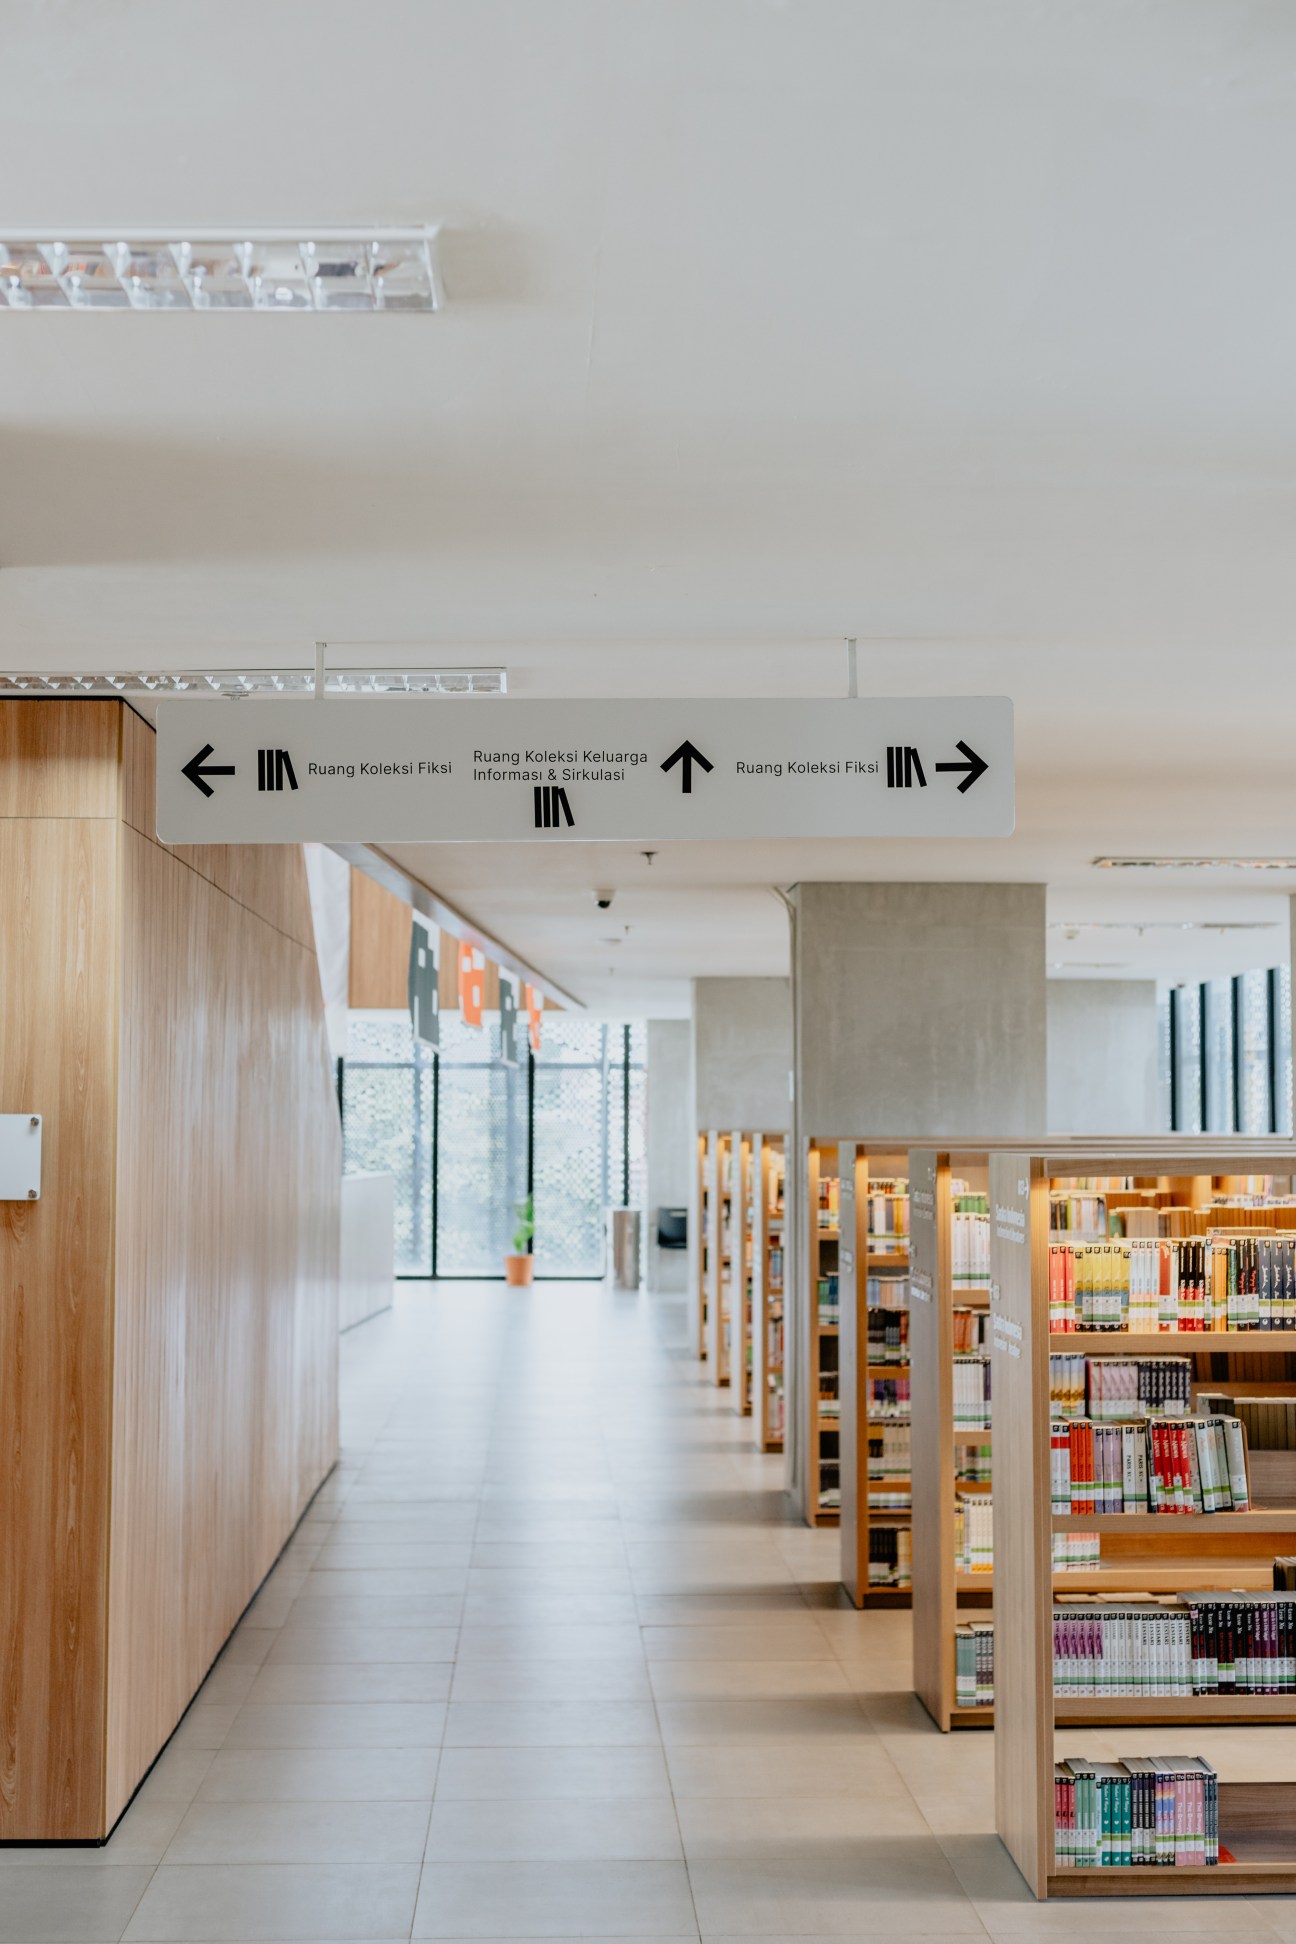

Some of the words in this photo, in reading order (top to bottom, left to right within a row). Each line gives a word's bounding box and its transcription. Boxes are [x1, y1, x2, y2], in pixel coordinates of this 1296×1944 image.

[474, 751, 519, 765] Ruang
[526, 750, 577, 762] Koleksi
[584, 751, 647, 765] Keluarga
[309, 763, 354, 777] Ruang
[361, 762, 412, 775] Koleksi
[419, 762, 451, 774] Fiksi
[474, 768, 542, 780] Informasi
[548, 769, 556, 780] &
[562, 769, 624, 780] Sirkulasi
[737, 762, 782, 776] Ruang
[788, 761, 839, 773] Koleksi
[846, 761, 878, 773] Fiksi
